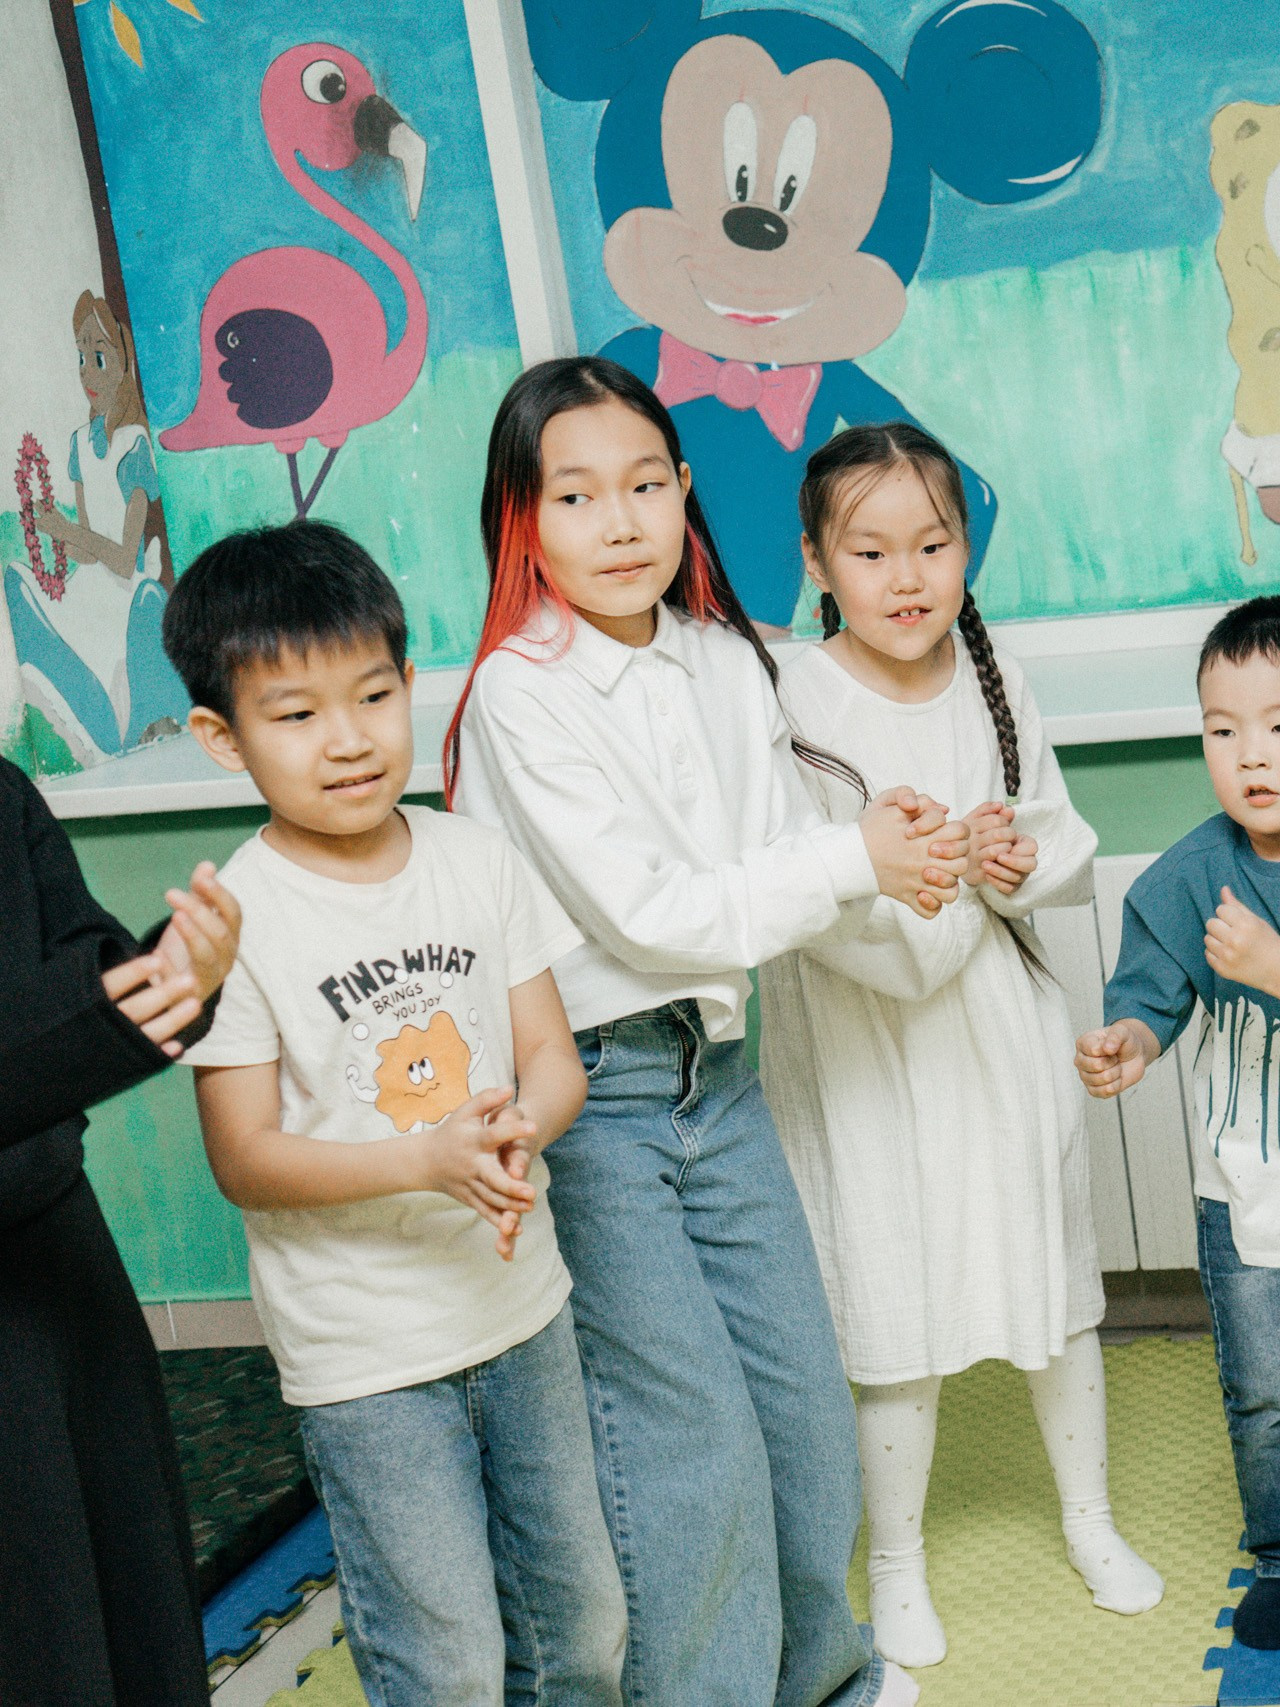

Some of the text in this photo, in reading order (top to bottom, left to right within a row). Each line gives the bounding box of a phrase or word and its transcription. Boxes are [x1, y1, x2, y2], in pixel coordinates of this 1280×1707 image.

[317, 943, 476, 1023] FIND WHAT
[371, 982, 424, 1015] BRINGS
[393, 995, 441, 1021] YOU JOY
